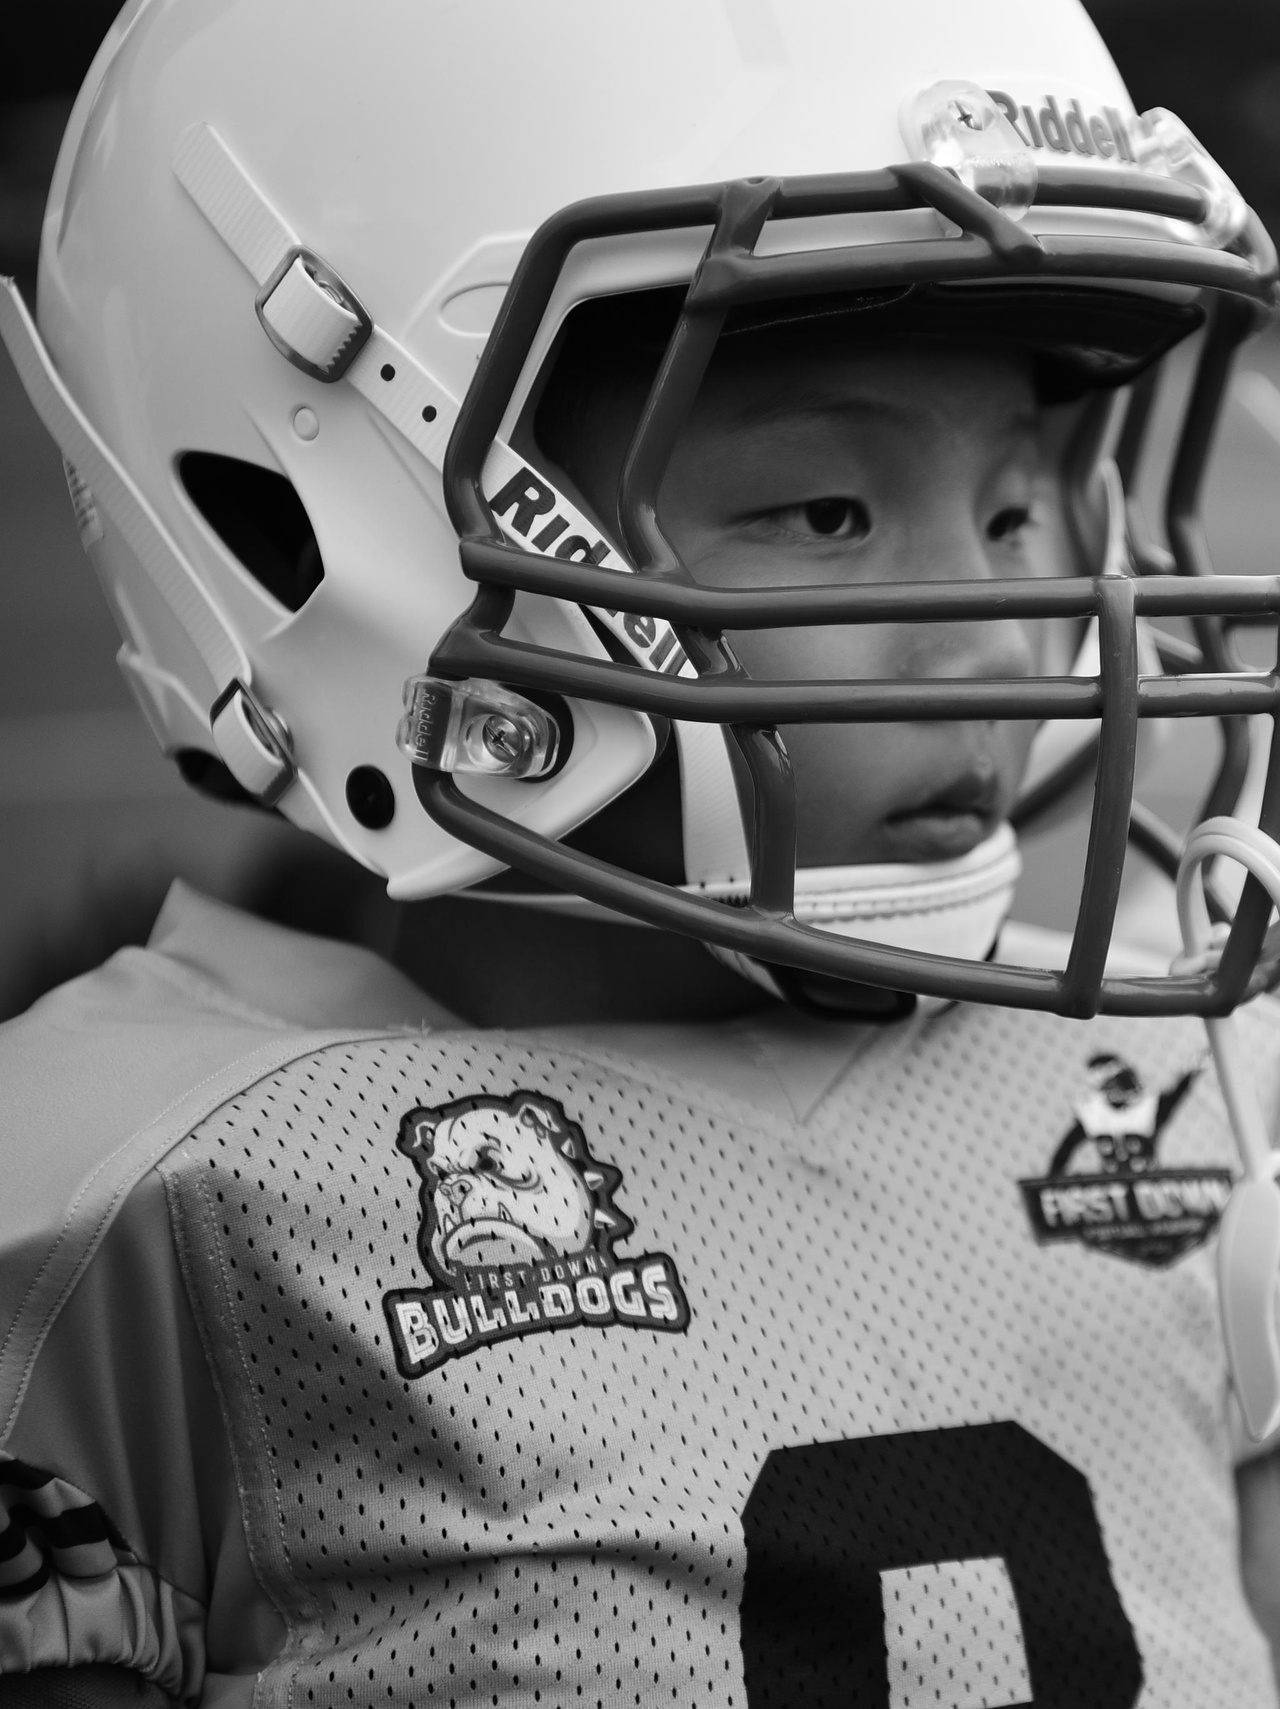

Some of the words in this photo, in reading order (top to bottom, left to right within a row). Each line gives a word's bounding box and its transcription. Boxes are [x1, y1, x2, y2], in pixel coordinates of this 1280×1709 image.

[1039, 1185, 1130, 1227] FIRST
[463, 1269, 527, 1291] FIRST
[540, 1255, 598, 1282] DOWN
[395, 1264, 679, 1365] BULLDOGS
